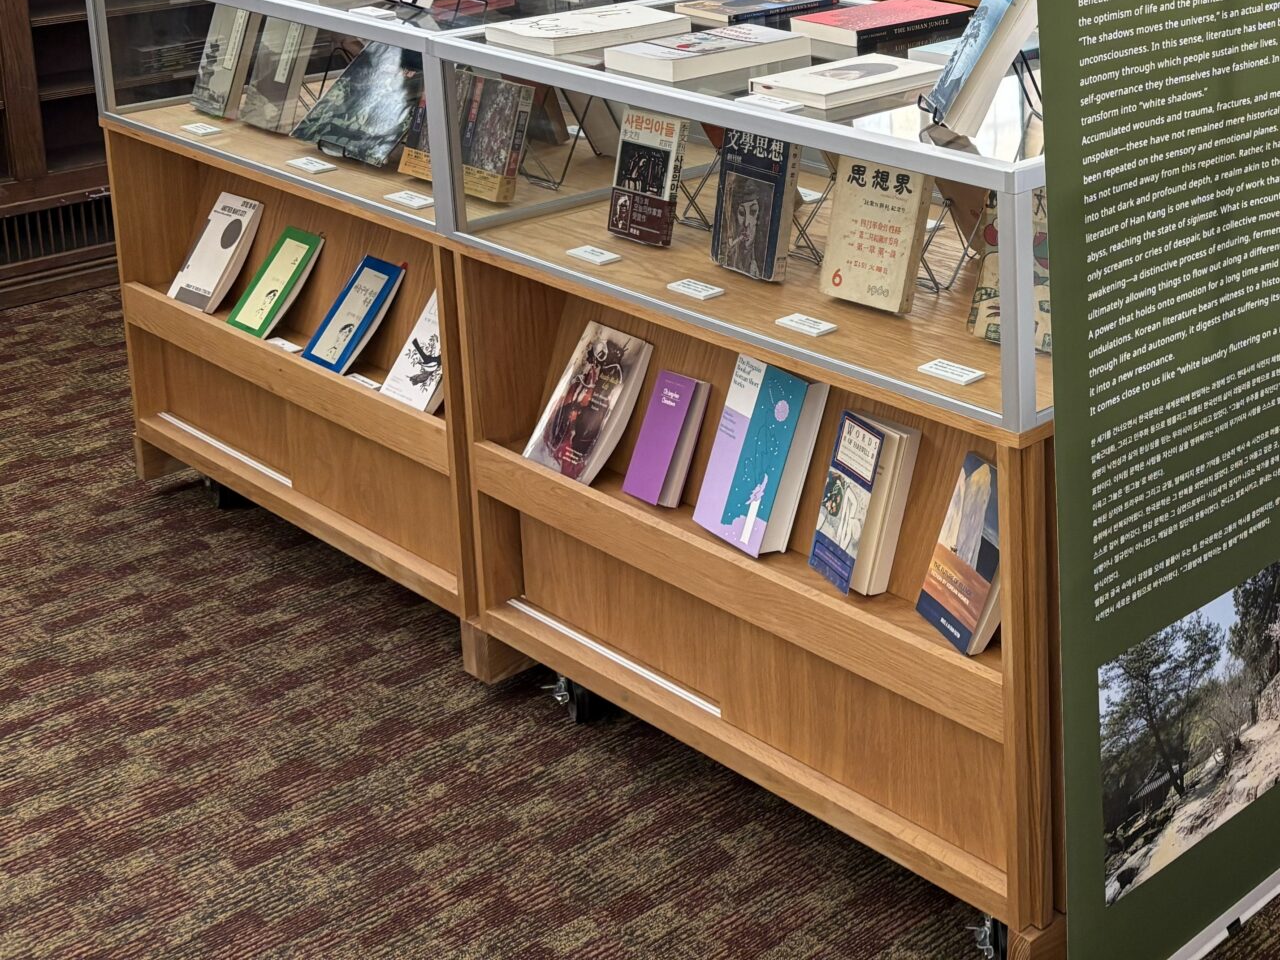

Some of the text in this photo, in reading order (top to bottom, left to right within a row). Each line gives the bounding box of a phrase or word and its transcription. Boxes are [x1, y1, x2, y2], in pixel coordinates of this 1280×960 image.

[906, 23, 927, 32] HUMAN
[929, 19, 949, 29] JUNGLE
[725, 129, 784, 161] 文學思想
[847, 165, 912, 195] 思想界
[832, 269, 842, 287] 6
[745, 361, 761, 373] Penguin
[1090, 407, 1096, 416] It
[1097, 395, 1121, 412] comes
[1121, 386, 1141, 400] close
[1142, 381, 1150, 391] to
[1151, 377, 1161, 386] us
[1162, 371, 1175, 382] like
[1176, 360, 1200, 374] “white
[1201, 348, 1228, 365] laundry
[1228, 334, 1261, 353] fluttering
[1262, 330, 1271, 339] on
[735, 371, 759, 388] Korean Short
[848, 423, 878, 450] WORDS
